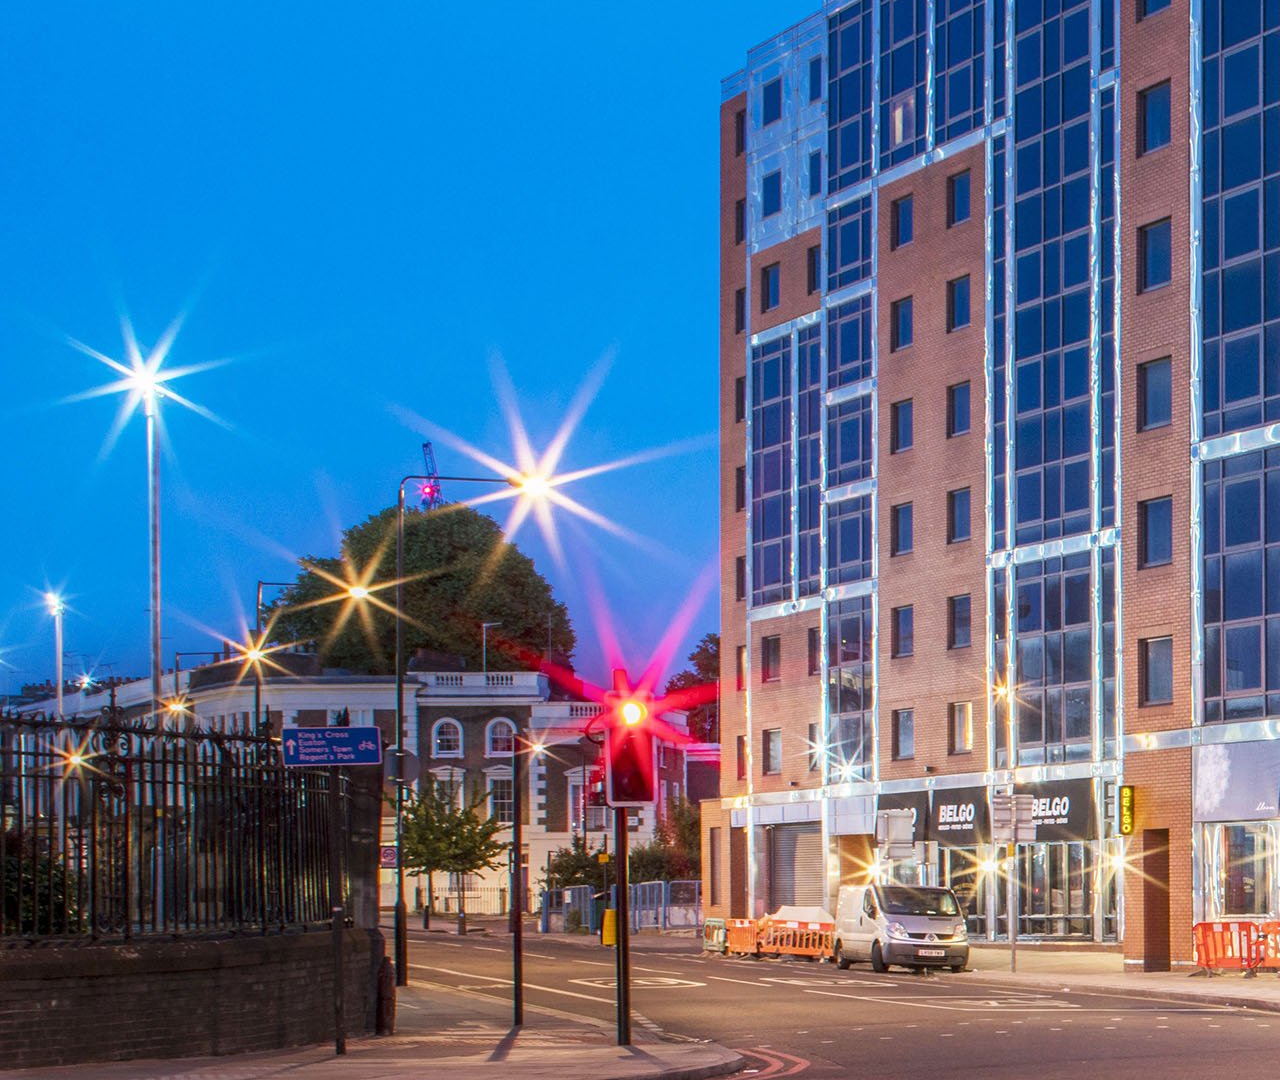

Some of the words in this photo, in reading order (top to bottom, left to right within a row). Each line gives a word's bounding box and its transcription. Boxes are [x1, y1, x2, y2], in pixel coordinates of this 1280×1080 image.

[938, 803, 975, 822] BELGO
[1032, 796, 1070, 817] BELGO
[1122, 787, 1132, 833] BELGO
